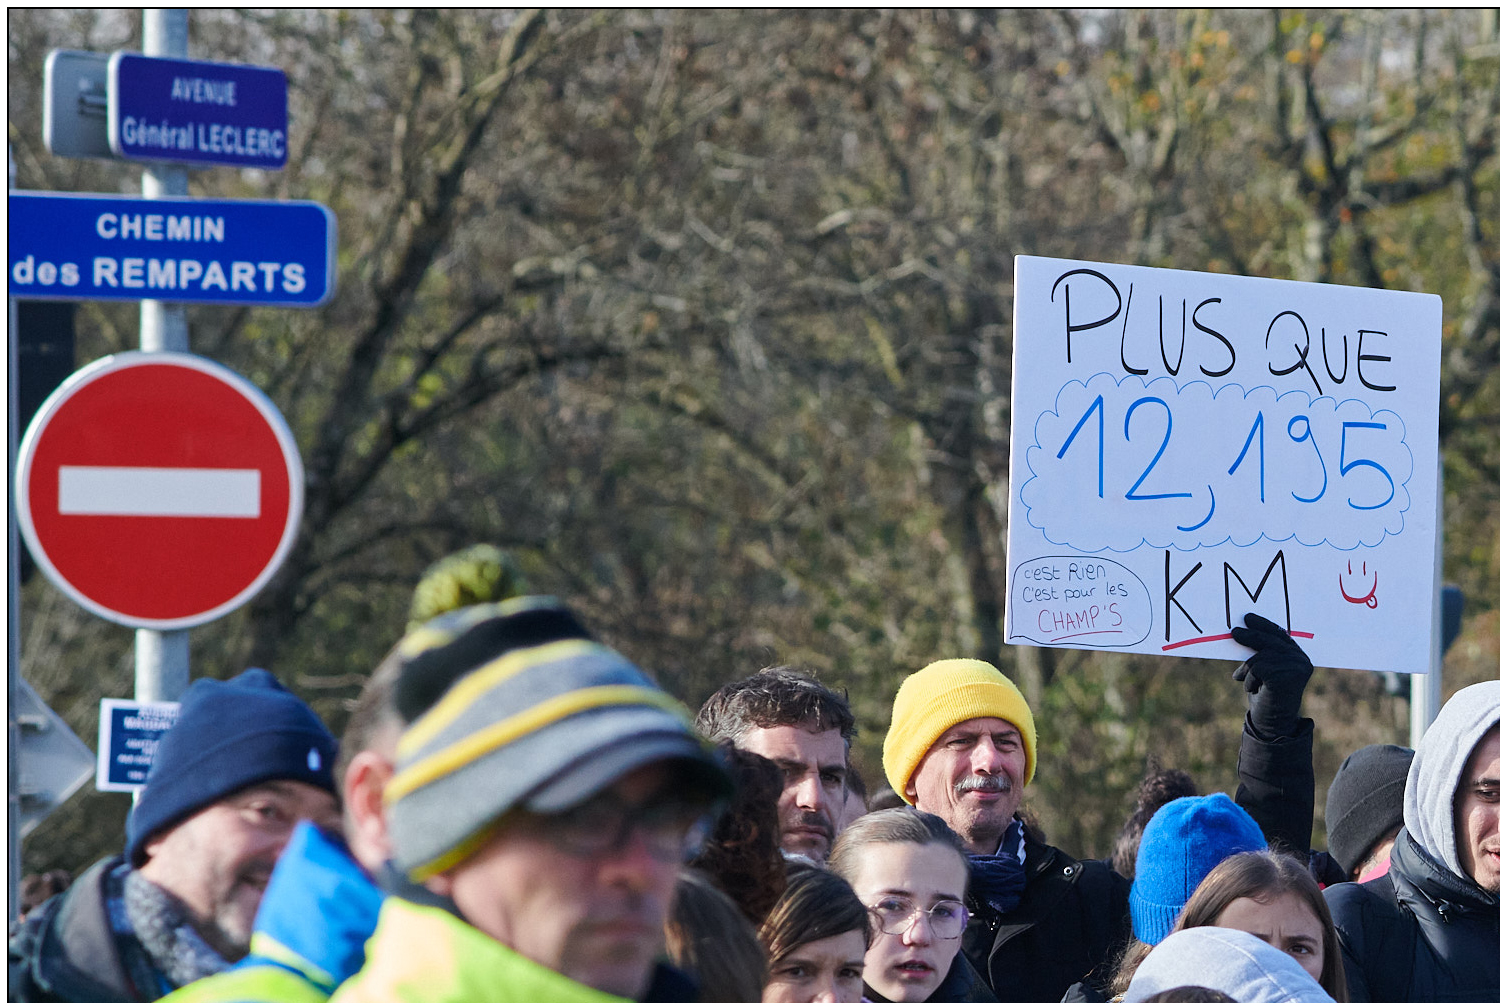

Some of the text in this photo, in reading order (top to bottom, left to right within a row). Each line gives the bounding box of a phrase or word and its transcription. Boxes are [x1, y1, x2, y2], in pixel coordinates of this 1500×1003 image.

[171, 76, 238, 106] AVENUE
[122, 116, 285, 158] Général LECLERC
[96, 213, 225, 242] CHEMIN
[13, 254, 307, 293] des REMPARTS
[1051, 268, 1397, 395] PLUS QUE
[1056, 394, 1396, 532] 12,195
[1068, 561, 1106, 581] Rien
[1064, 587, 1096, 602] pour
[1106, 582, 1129, 597] les
[1165, 550, 1291, 642] KM
[1038, 602, 1123, 633] CHAMP'S
